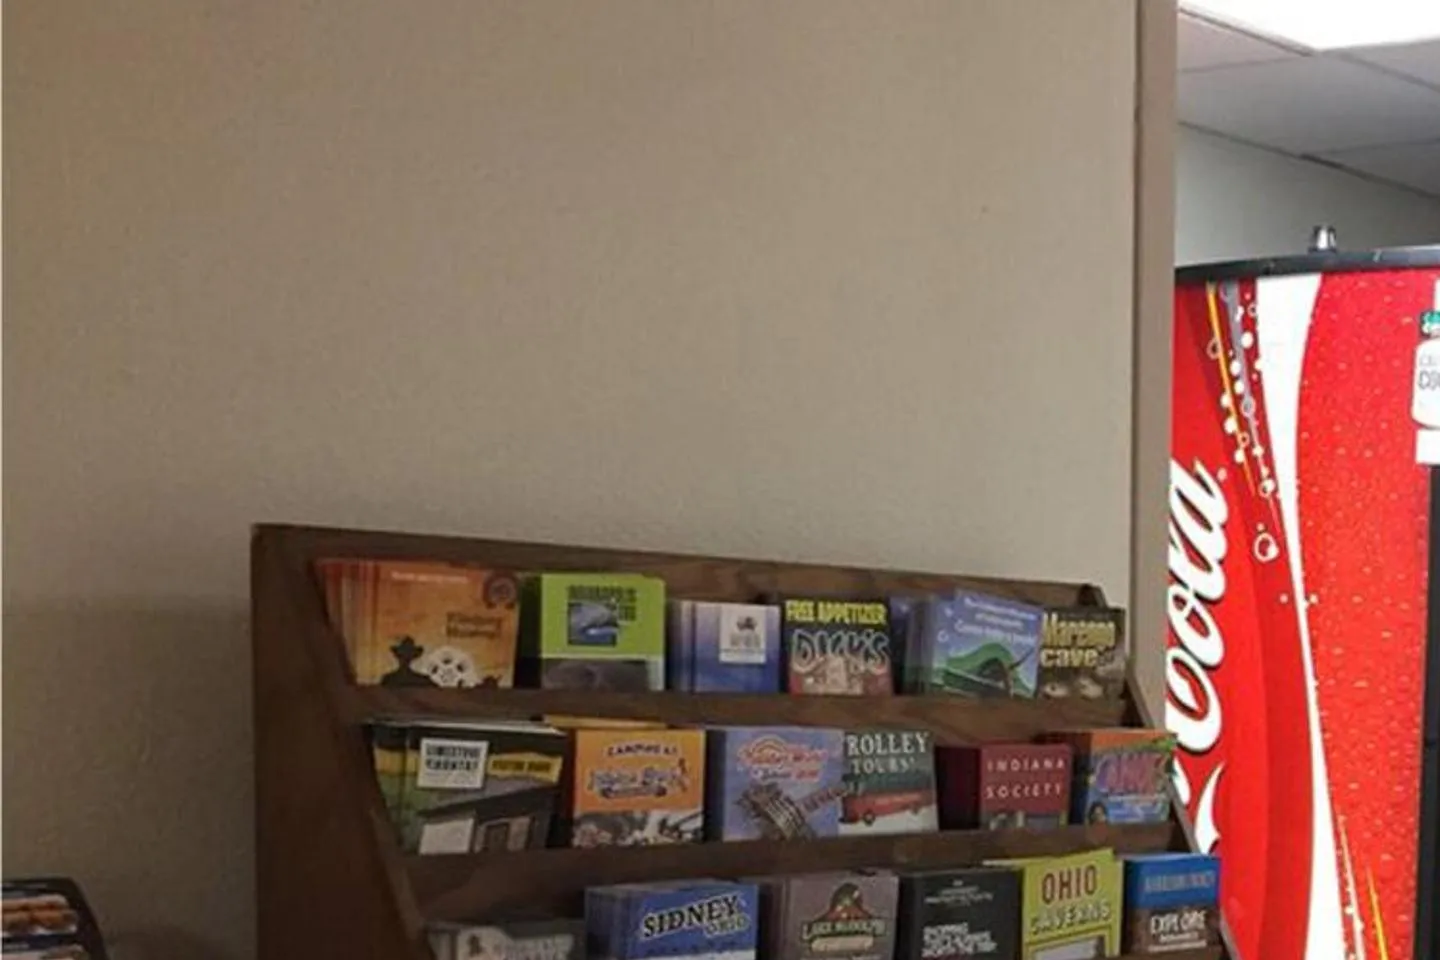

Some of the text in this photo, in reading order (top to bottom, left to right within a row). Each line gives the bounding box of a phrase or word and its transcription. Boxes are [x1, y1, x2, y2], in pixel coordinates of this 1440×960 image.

[846, 731, 929, 757] ROLLEY
[986, 758, 1065, 772] INDIANA
[985, 783, 1062, 799] SOCIETY
[1041, 865, 1098, 904] OHIO
[642, 894, 739, 939] SIDNEY
[1032, 901, 1111, 935] CAVERNS
